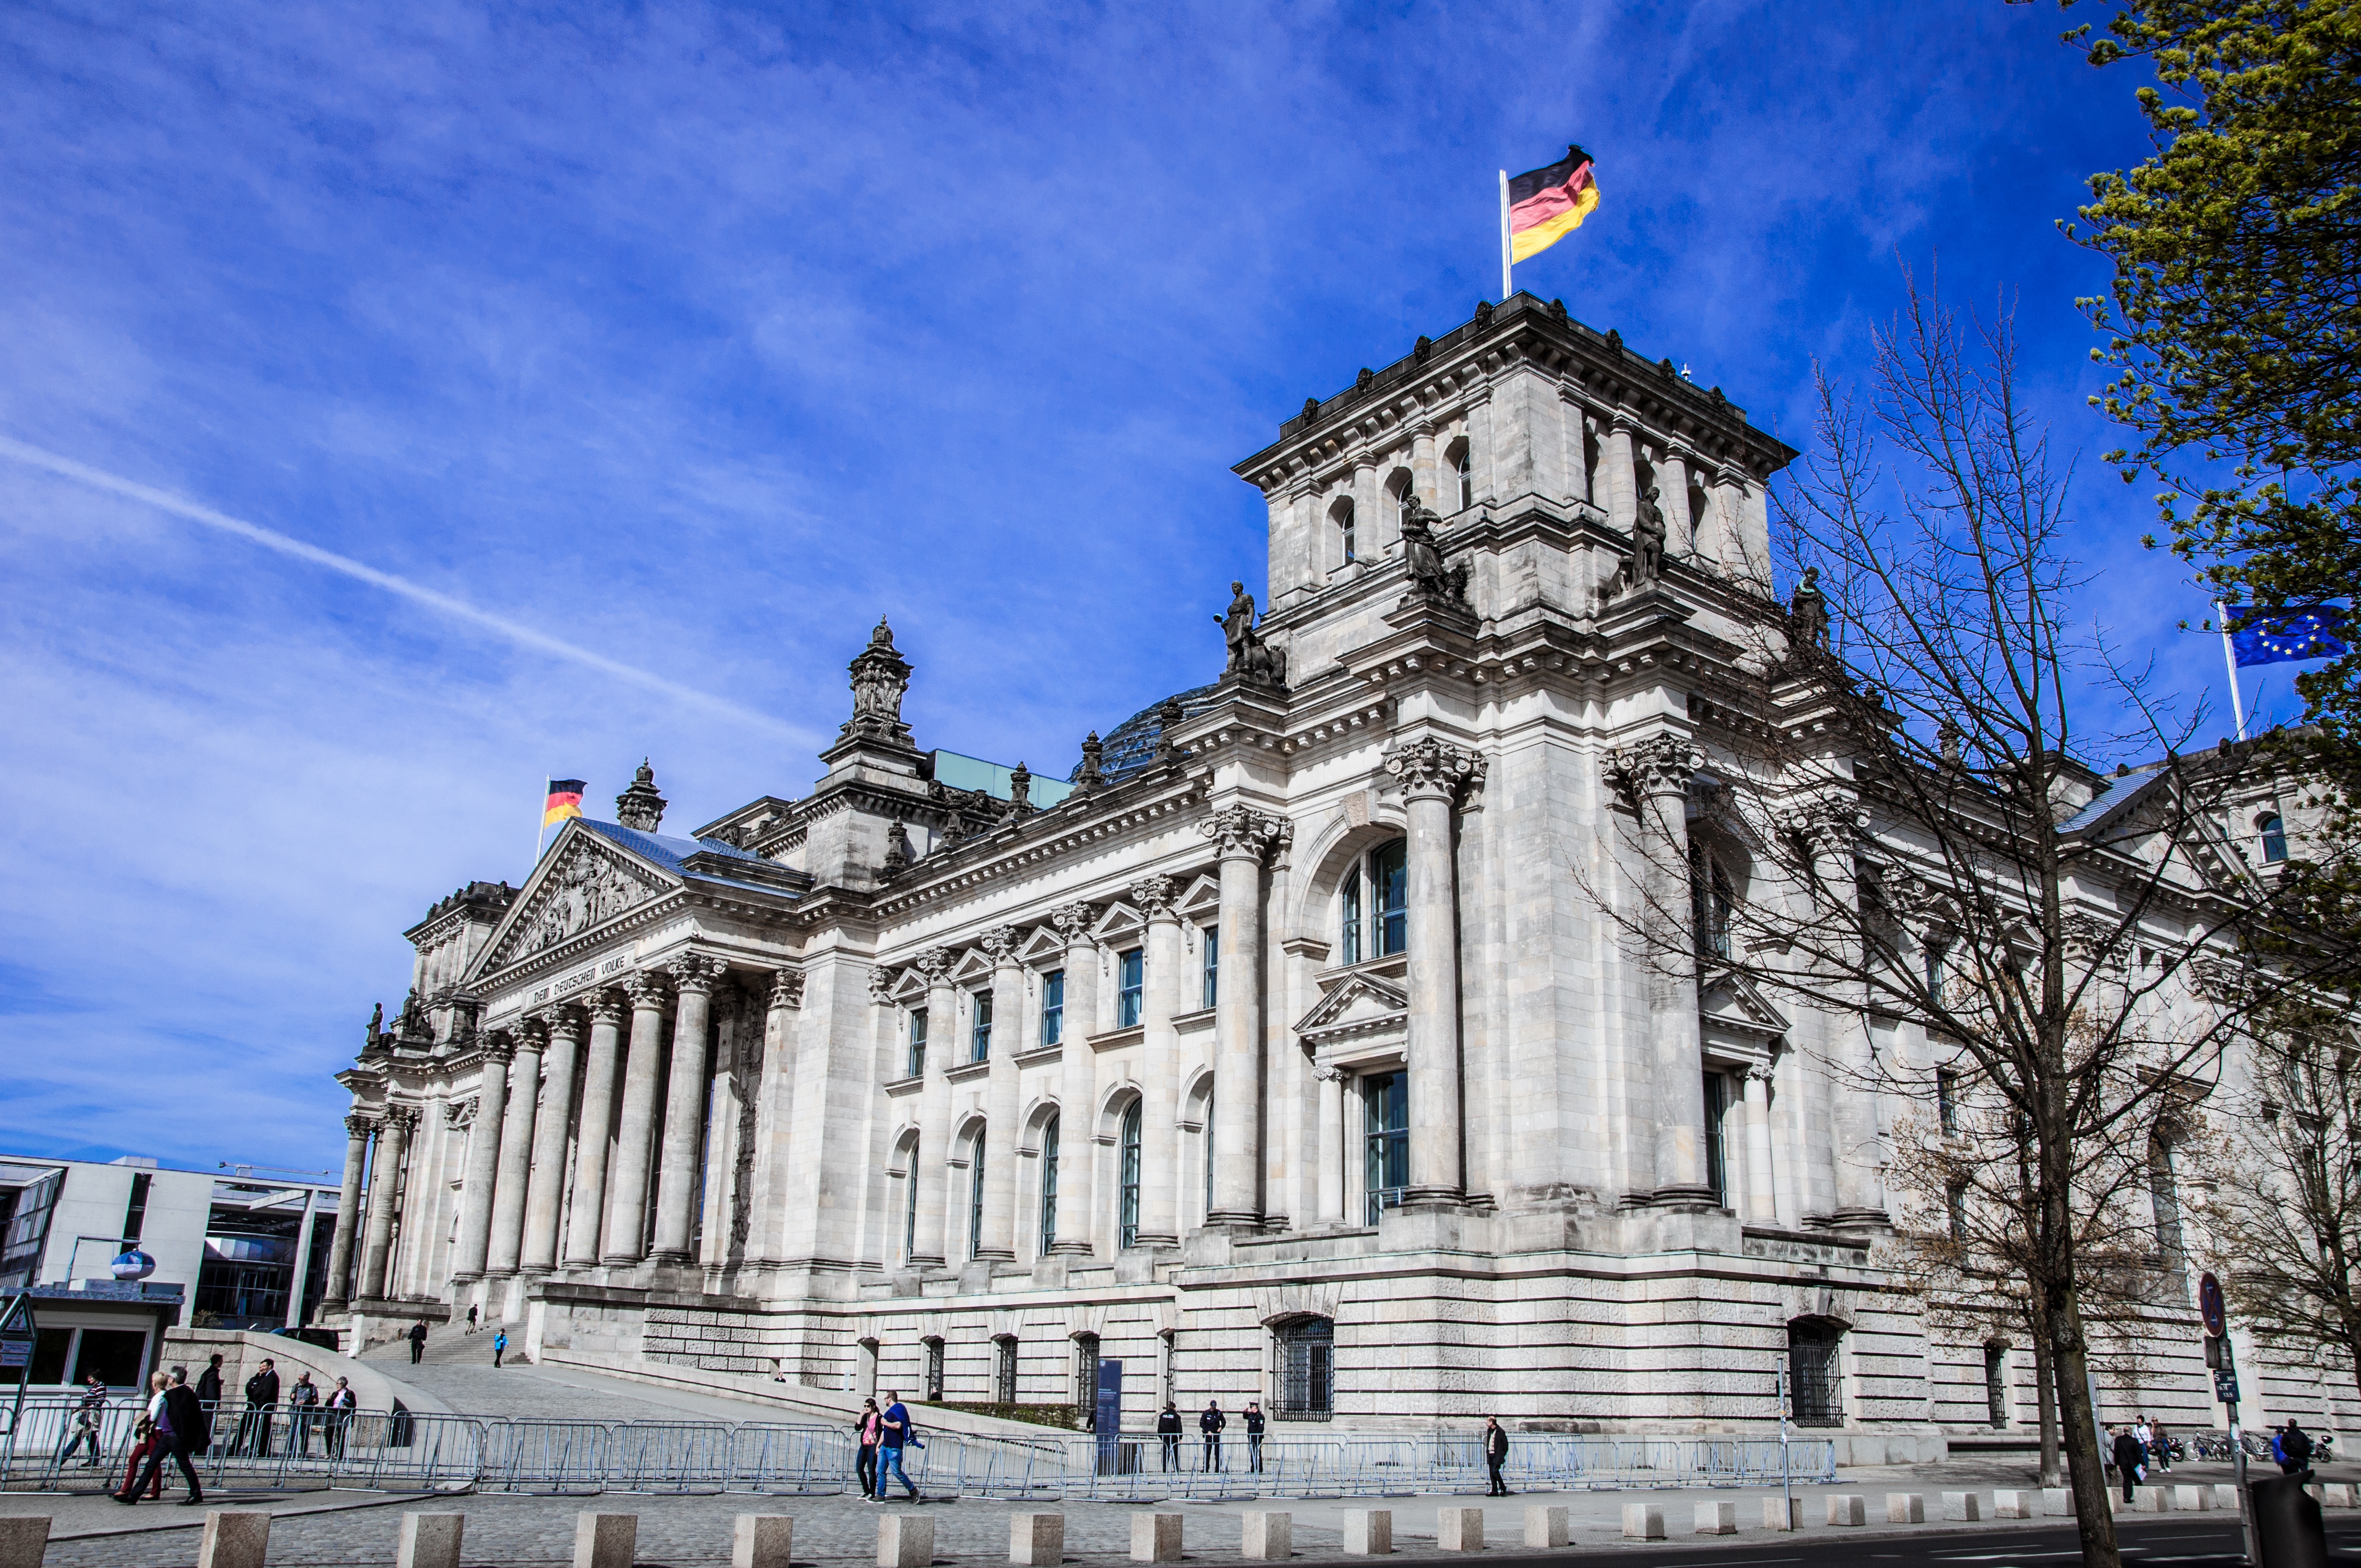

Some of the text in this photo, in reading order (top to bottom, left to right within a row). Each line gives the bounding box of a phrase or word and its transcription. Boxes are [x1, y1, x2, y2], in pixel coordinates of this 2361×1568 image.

[534, 955, 625, 1003] DEM DEUTSCHEN VOLKE
